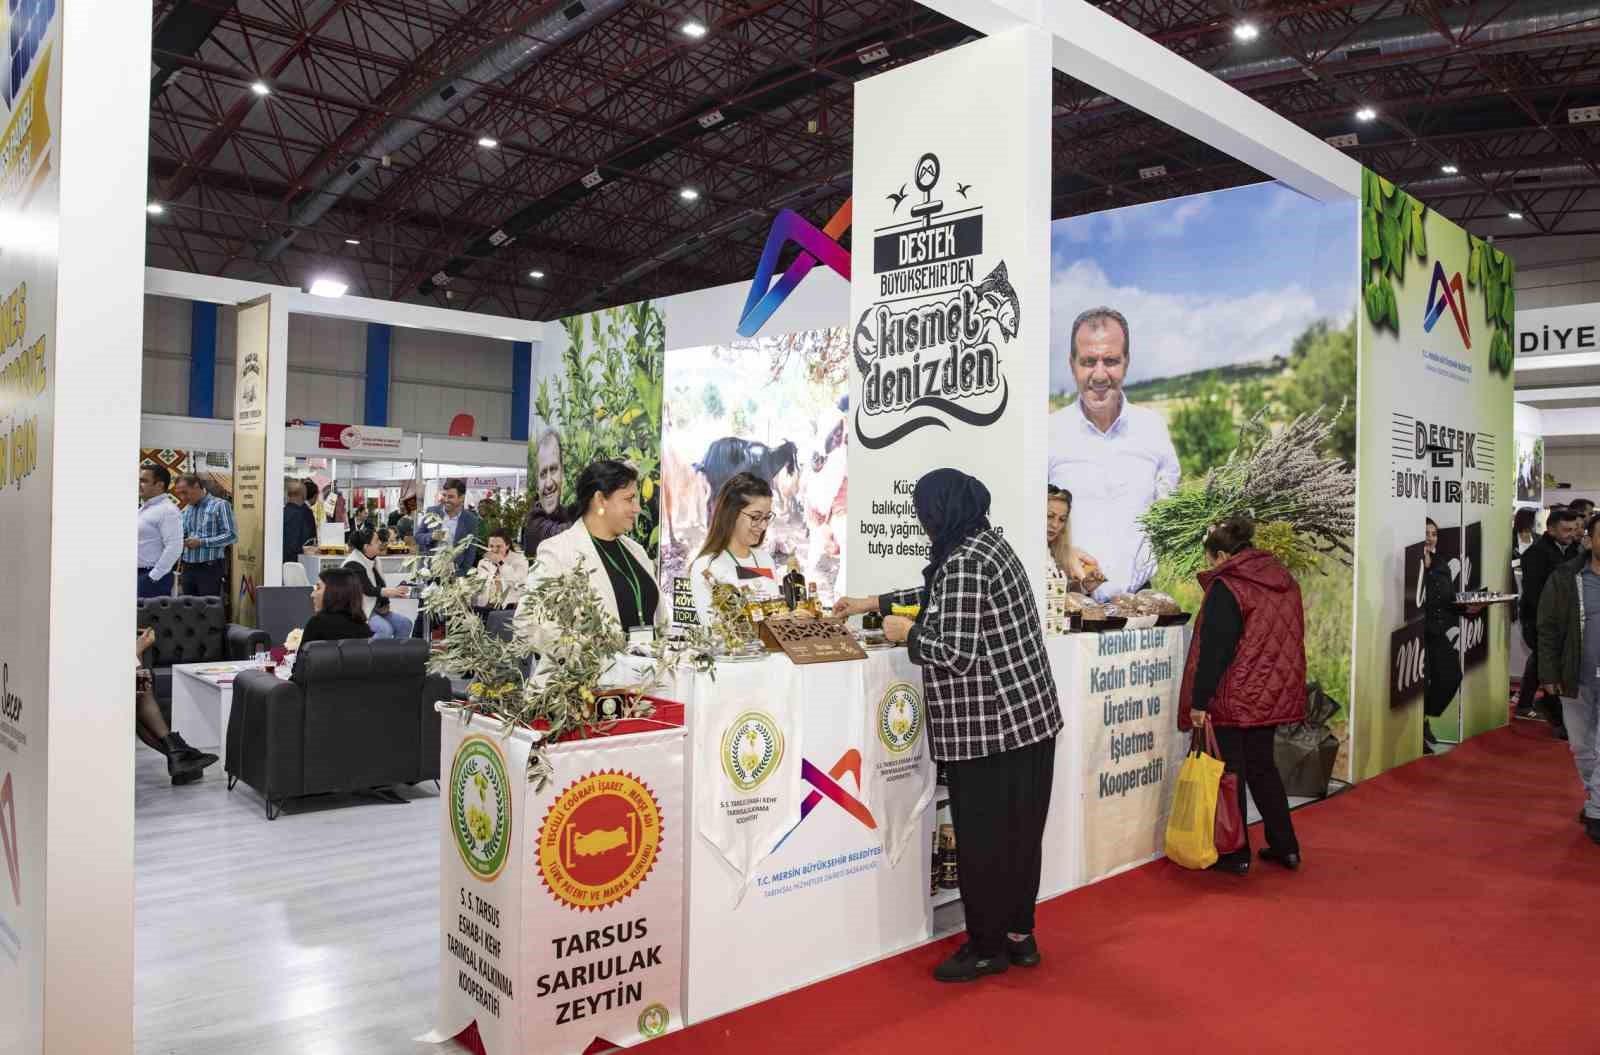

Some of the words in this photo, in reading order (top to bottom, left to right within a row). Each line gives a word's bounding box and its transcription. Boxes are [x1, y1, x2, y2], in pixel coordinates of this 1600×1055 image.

[900, 225, 956, 265] DESTEK
[880, 257, 974, 298] BÜYÜKŞEHİR'DEN
[1520, 325, 1595, 353] DİYE
[866, 343, 999, 411] denizden
[893, 480, 918, 496] Küç
[860, 520, 888, 536] boya,
[890, 520, 928, 540] yağmu
[868, 541, 894, 558] tutya
[896, 541, 932, 561] desteğ
[674, 610, 700, 623] TOPLA
[1098, 630, 1137, 657] Renkli
[1090, 664, 1126, 693] Kadın
[1129, 656, 1172, 687] Girişimi
[1103, 695, 1143, 726] Üretim
[1147, 696, 1161, 715] ve
[1110, 730, 1154, 764] İşletme
[771, 865, 801, 882] MERSİN
[802, 854, 847, 875] BÜYÜKŞEHİR
[460, 886, 467, 908] S.
[467, 891, 474, 912] S.
[475, 895, 500, 929] TARSUS
[459, 914, 484, 947] ESHAB-I
[485, 930, 502, 960] KEHF
[551, 917, 649, 960] TARSUS
[447, 932, 478, 972] TARIMSAL
[478, 956, 514, 1001] KALKINMA
[536, 944, 664, 998] SARIULAK
[458, 969, 500, 1019] KOOPERATİFİ
[555, 982, 643, 1026] ZEYTİN
